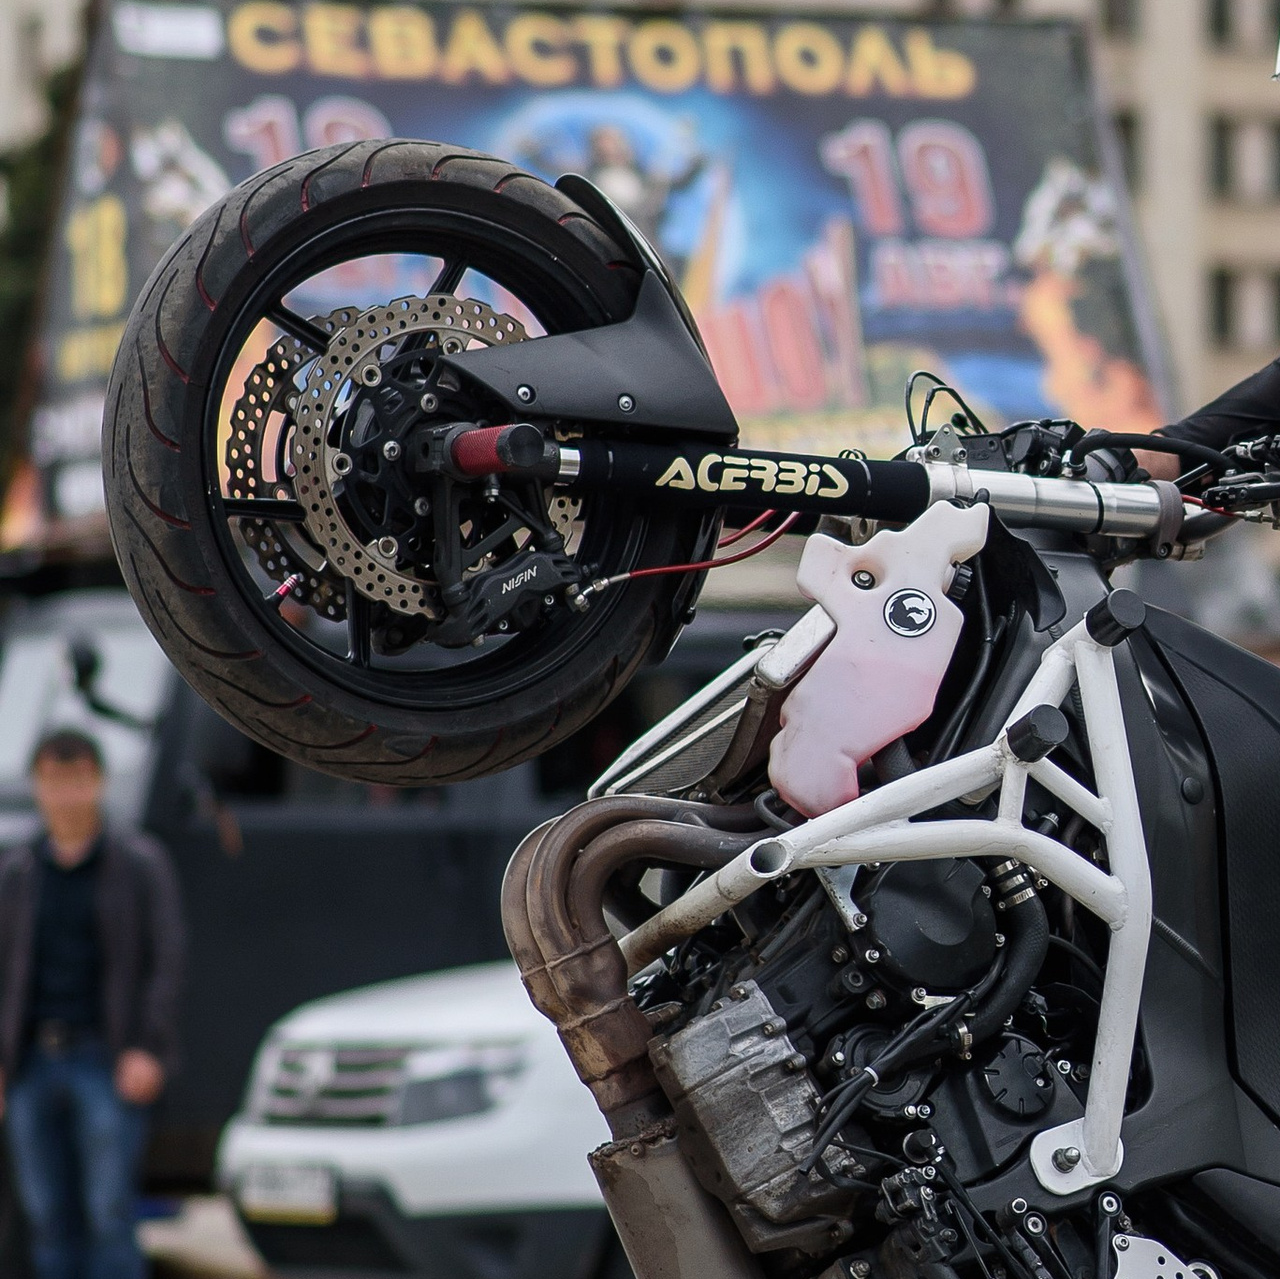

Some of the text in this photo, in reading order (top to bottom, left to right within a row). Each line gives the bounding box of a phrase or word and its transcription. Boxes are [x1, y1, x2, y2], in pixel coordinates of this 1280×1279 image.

[227, 0, 977, 101] СЕВАСТОПОЛЬ
[819, 118, 995, 240] 19
[501, 565, 538, 595] NISSIN
